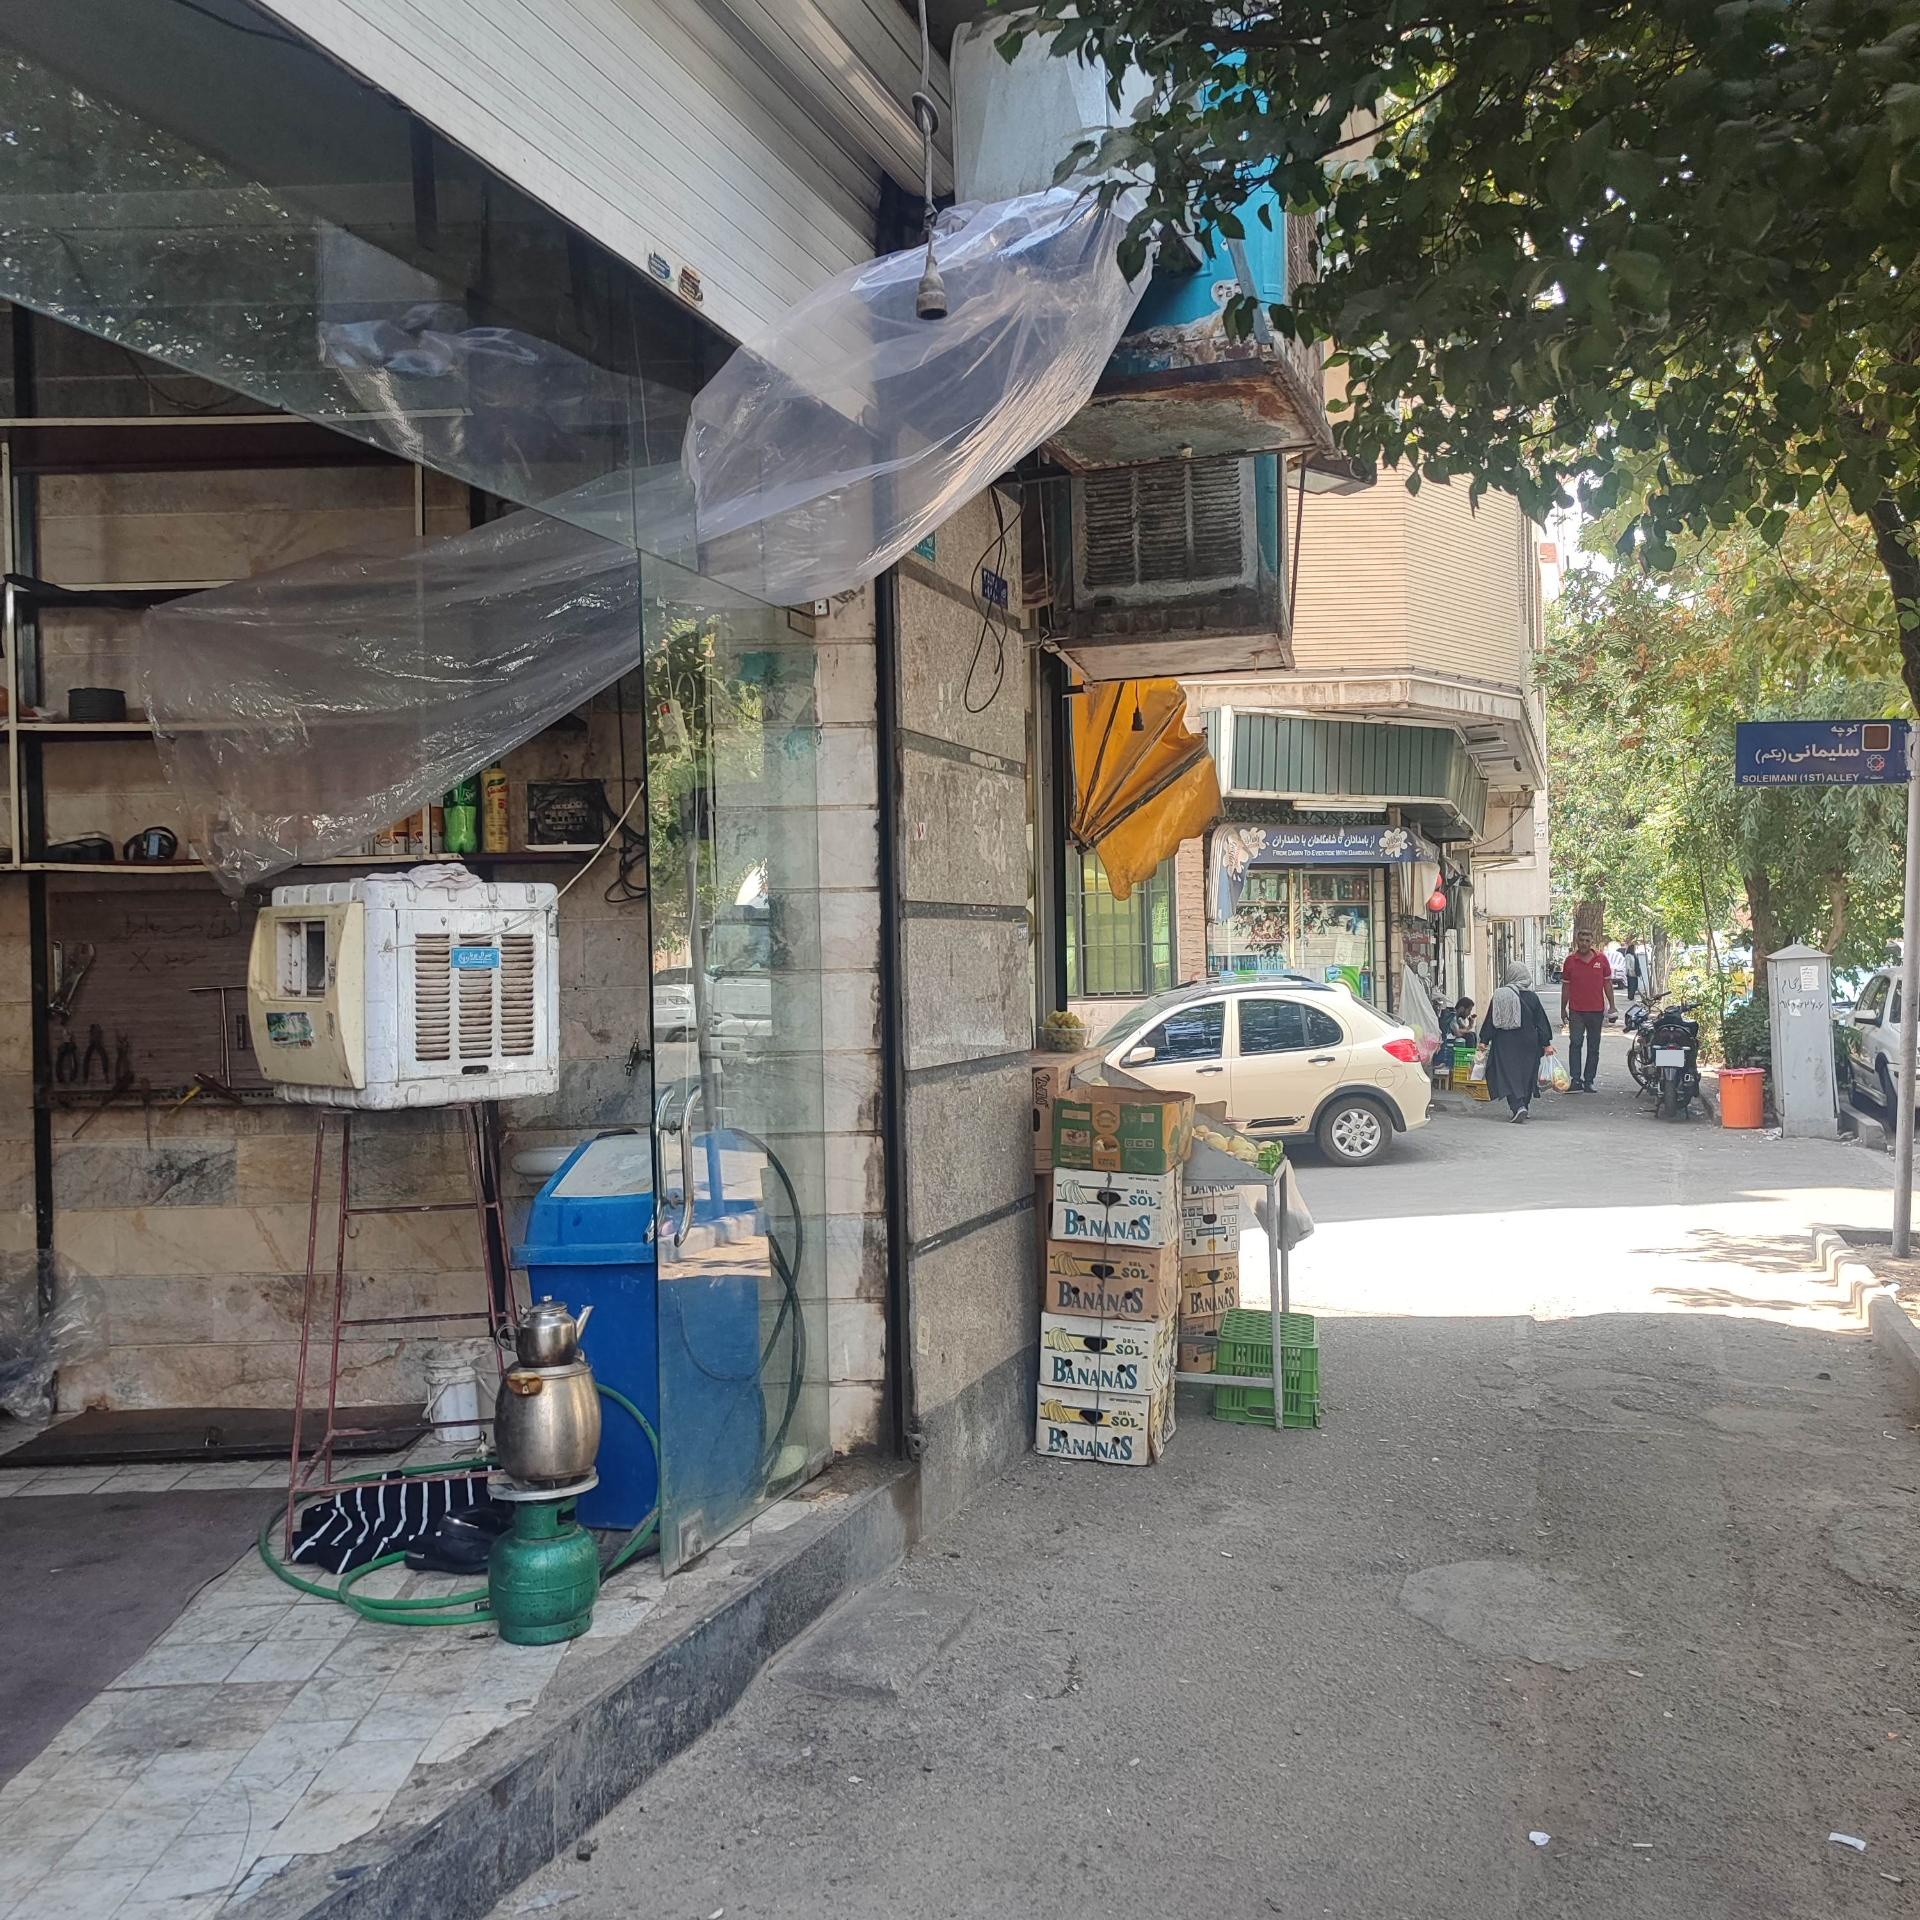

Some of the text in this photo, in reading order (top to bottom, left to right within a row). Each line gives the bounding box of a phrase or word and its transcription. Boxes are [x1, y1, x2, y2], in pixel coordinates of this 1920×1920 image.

[1830, 724, 1860, 737] کوچه
[1788, 743, 1860, 763] سلیمانی
[1742, 774, 1797, 783] SOLEIMANI
[1800, 773, 1825, 783] (1ST)
[1826, 773, 1860, 783] ALLEY
[1129, 1195, 1157, 1207] SOL
[1064, 1208, 1151, 1241] BANANAS
[1121, 1267, 1149, 1280] SOL
[1223, 1270, 1237, 1281] SOL
[1057, 1281, 1144, 1314] BANANAS
[1190, 1286, 1235, 1314] BANANAS
[1115, 1344, 1143, 1356] SOL
[1052, 1356, 1138, 1389] BANANAS
[1110, 1416, 1139, 1428] SOL
[1047, 1426, 1133, 1460] BANANAS
